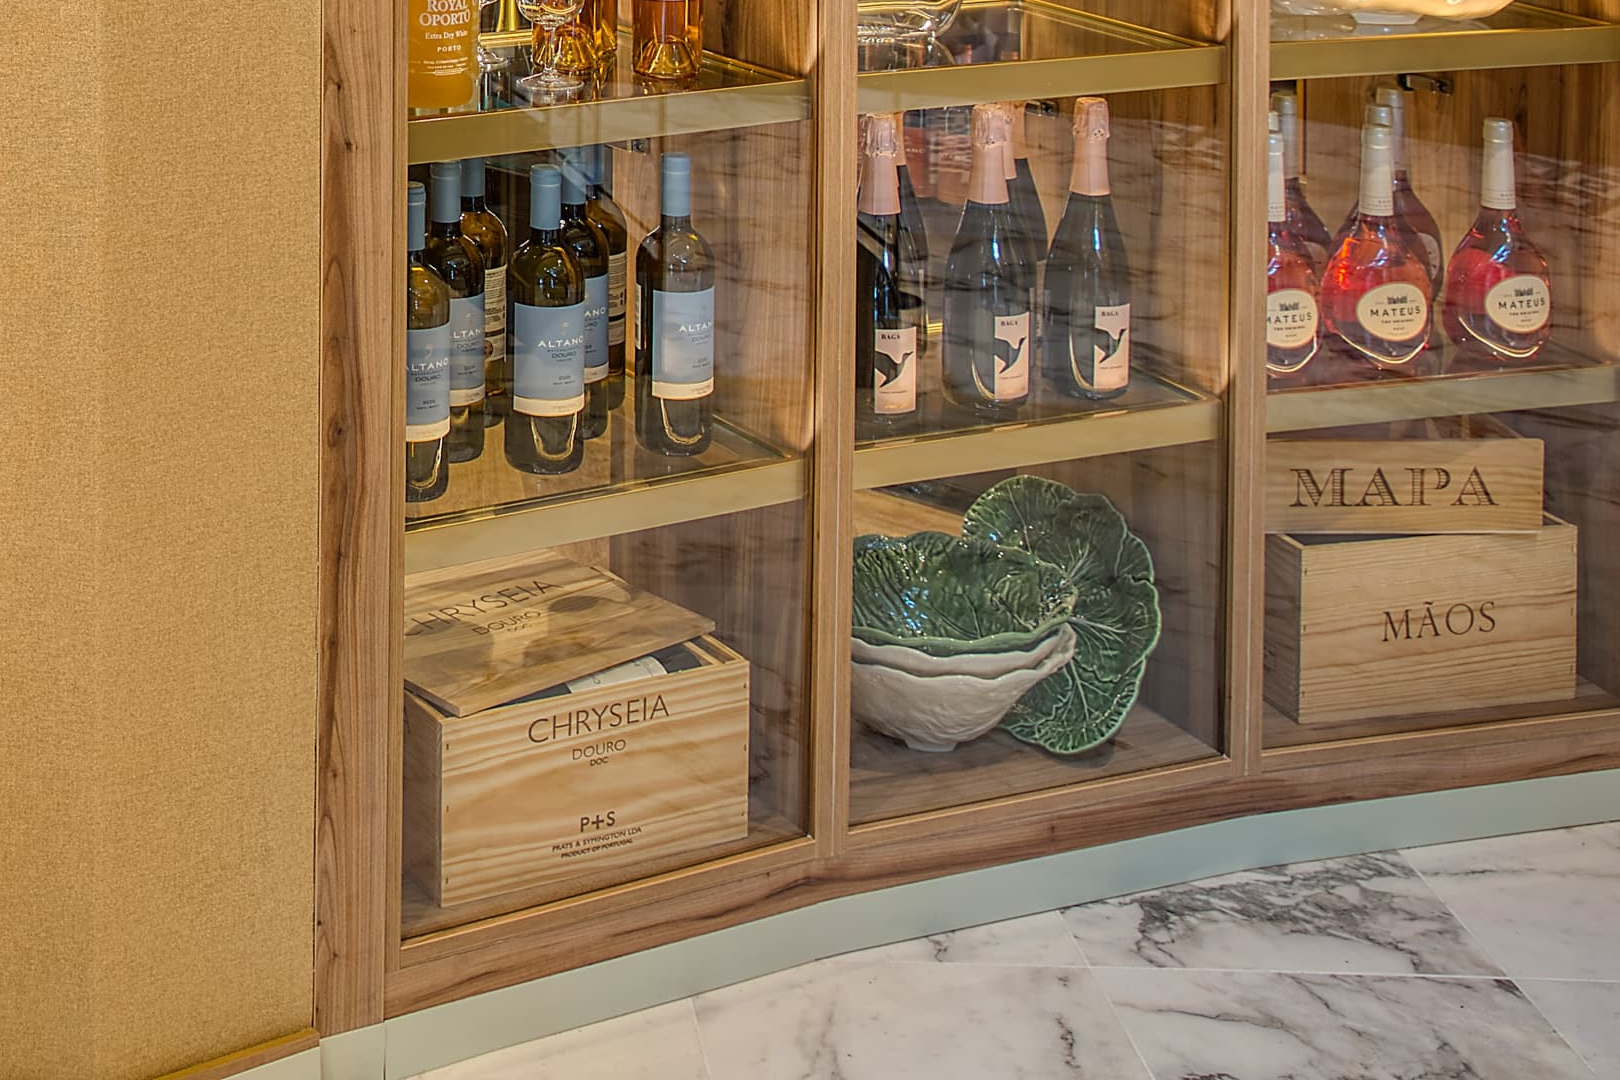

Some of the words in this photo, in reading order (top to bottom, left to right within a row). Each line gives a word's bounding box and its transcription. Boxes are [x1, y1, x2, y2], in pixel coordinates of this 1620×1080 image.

[419, 9, 470, 26] OPORTO
[436, 44, 462, 53] PORTO
[1370, 306, 1420, 317] MATEUS
[1498, 297, 1545, 309] MATEUS
[1290, 467, 1499, 507] MAPA
[472, 610, 541, 635] DOURO
[1382, 601, 1496, 642] MÃOS
[528, 694, 669, 743] CHRYSEIA
[572, 739, 627, 760] DOURO
[590, 756, 609, 766] DOC
[580, 811, 616, 832] P+S
[582, 830, 626, 846] SYMINGTON
[627, 826, 642, 836] LDA
[561, 847, 590, 858] PRODUCT
[591, 845, 600, 853] OF
[601, 838, 633, 851] PORTUGAL
